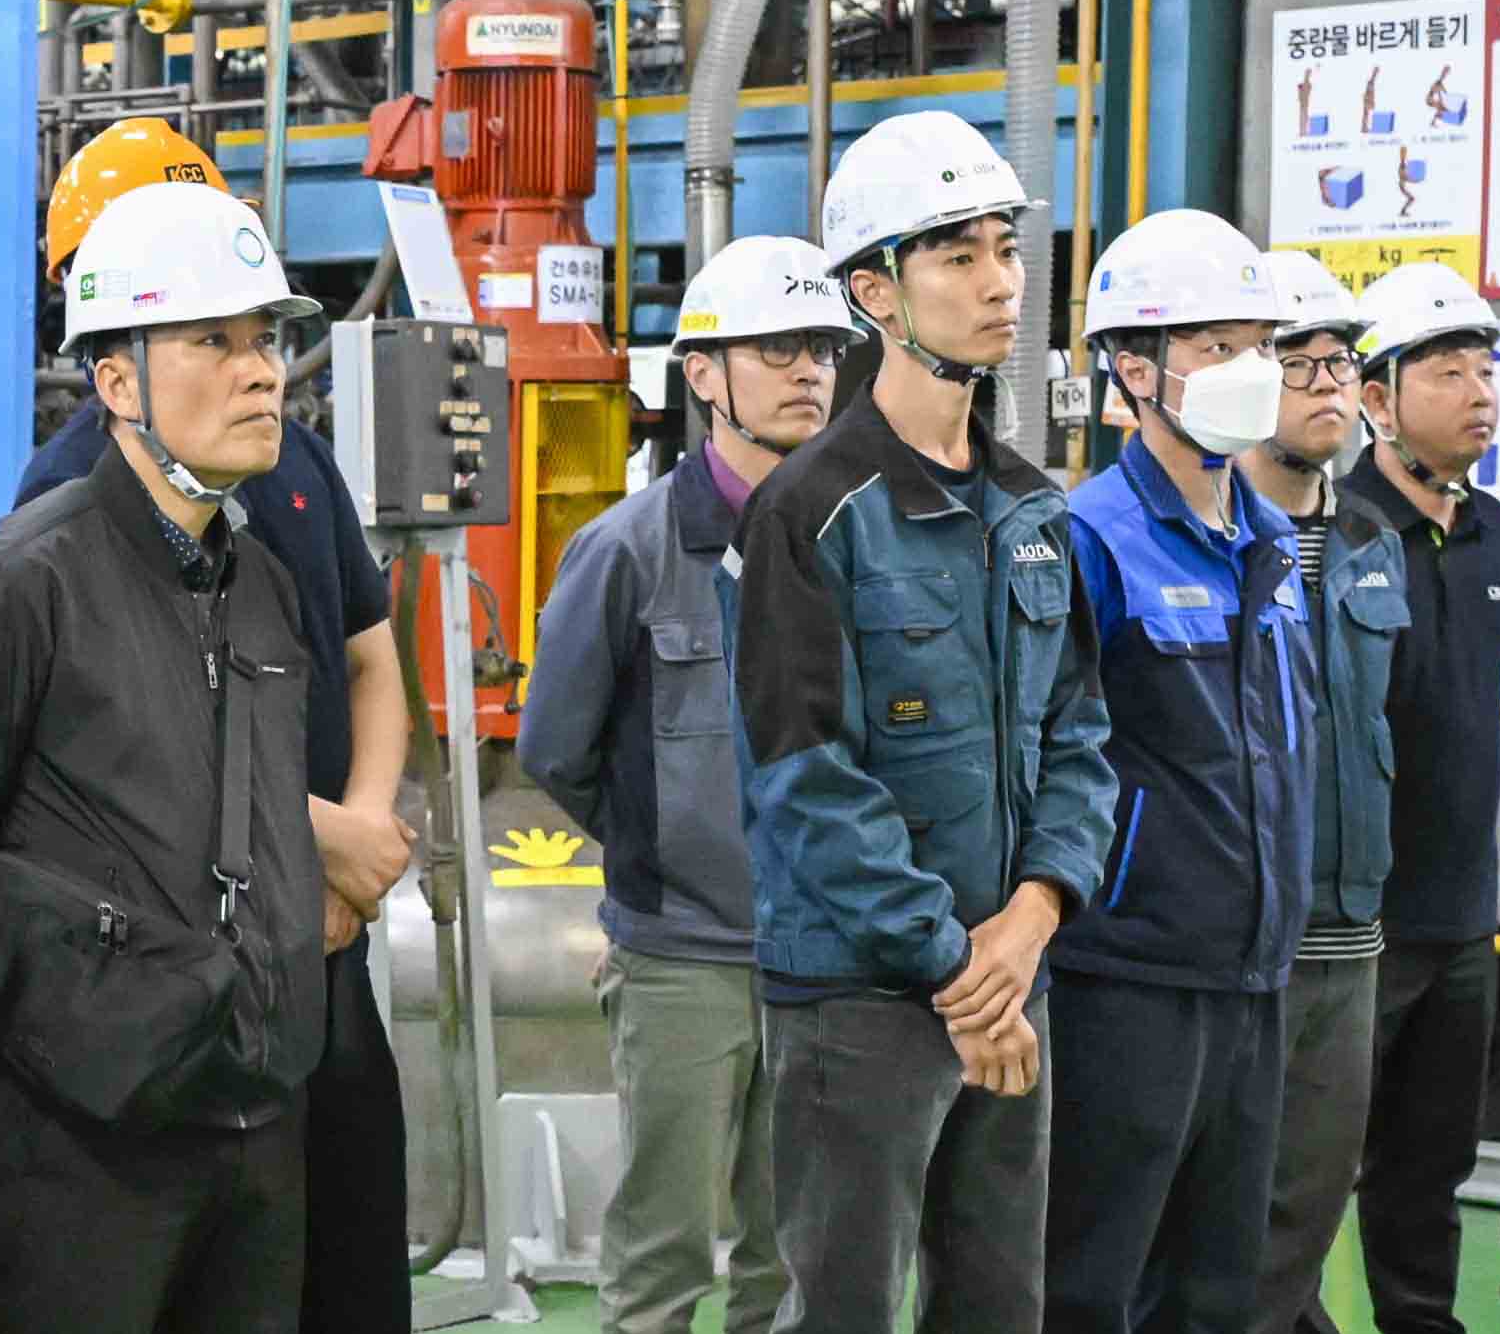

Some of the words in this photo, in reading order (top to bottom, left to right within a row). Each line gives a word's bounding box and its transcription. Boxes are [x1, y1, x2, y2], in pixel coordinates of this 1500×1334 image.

[490, 22, 558, 36] HYUNDAI
[1288, 24, 1350, 59] 중량물
[1356, 17, 1420, 52] 바르게
[1426, 13, 1470, 46] 들기
[169, 165, 204, 182] KCC
